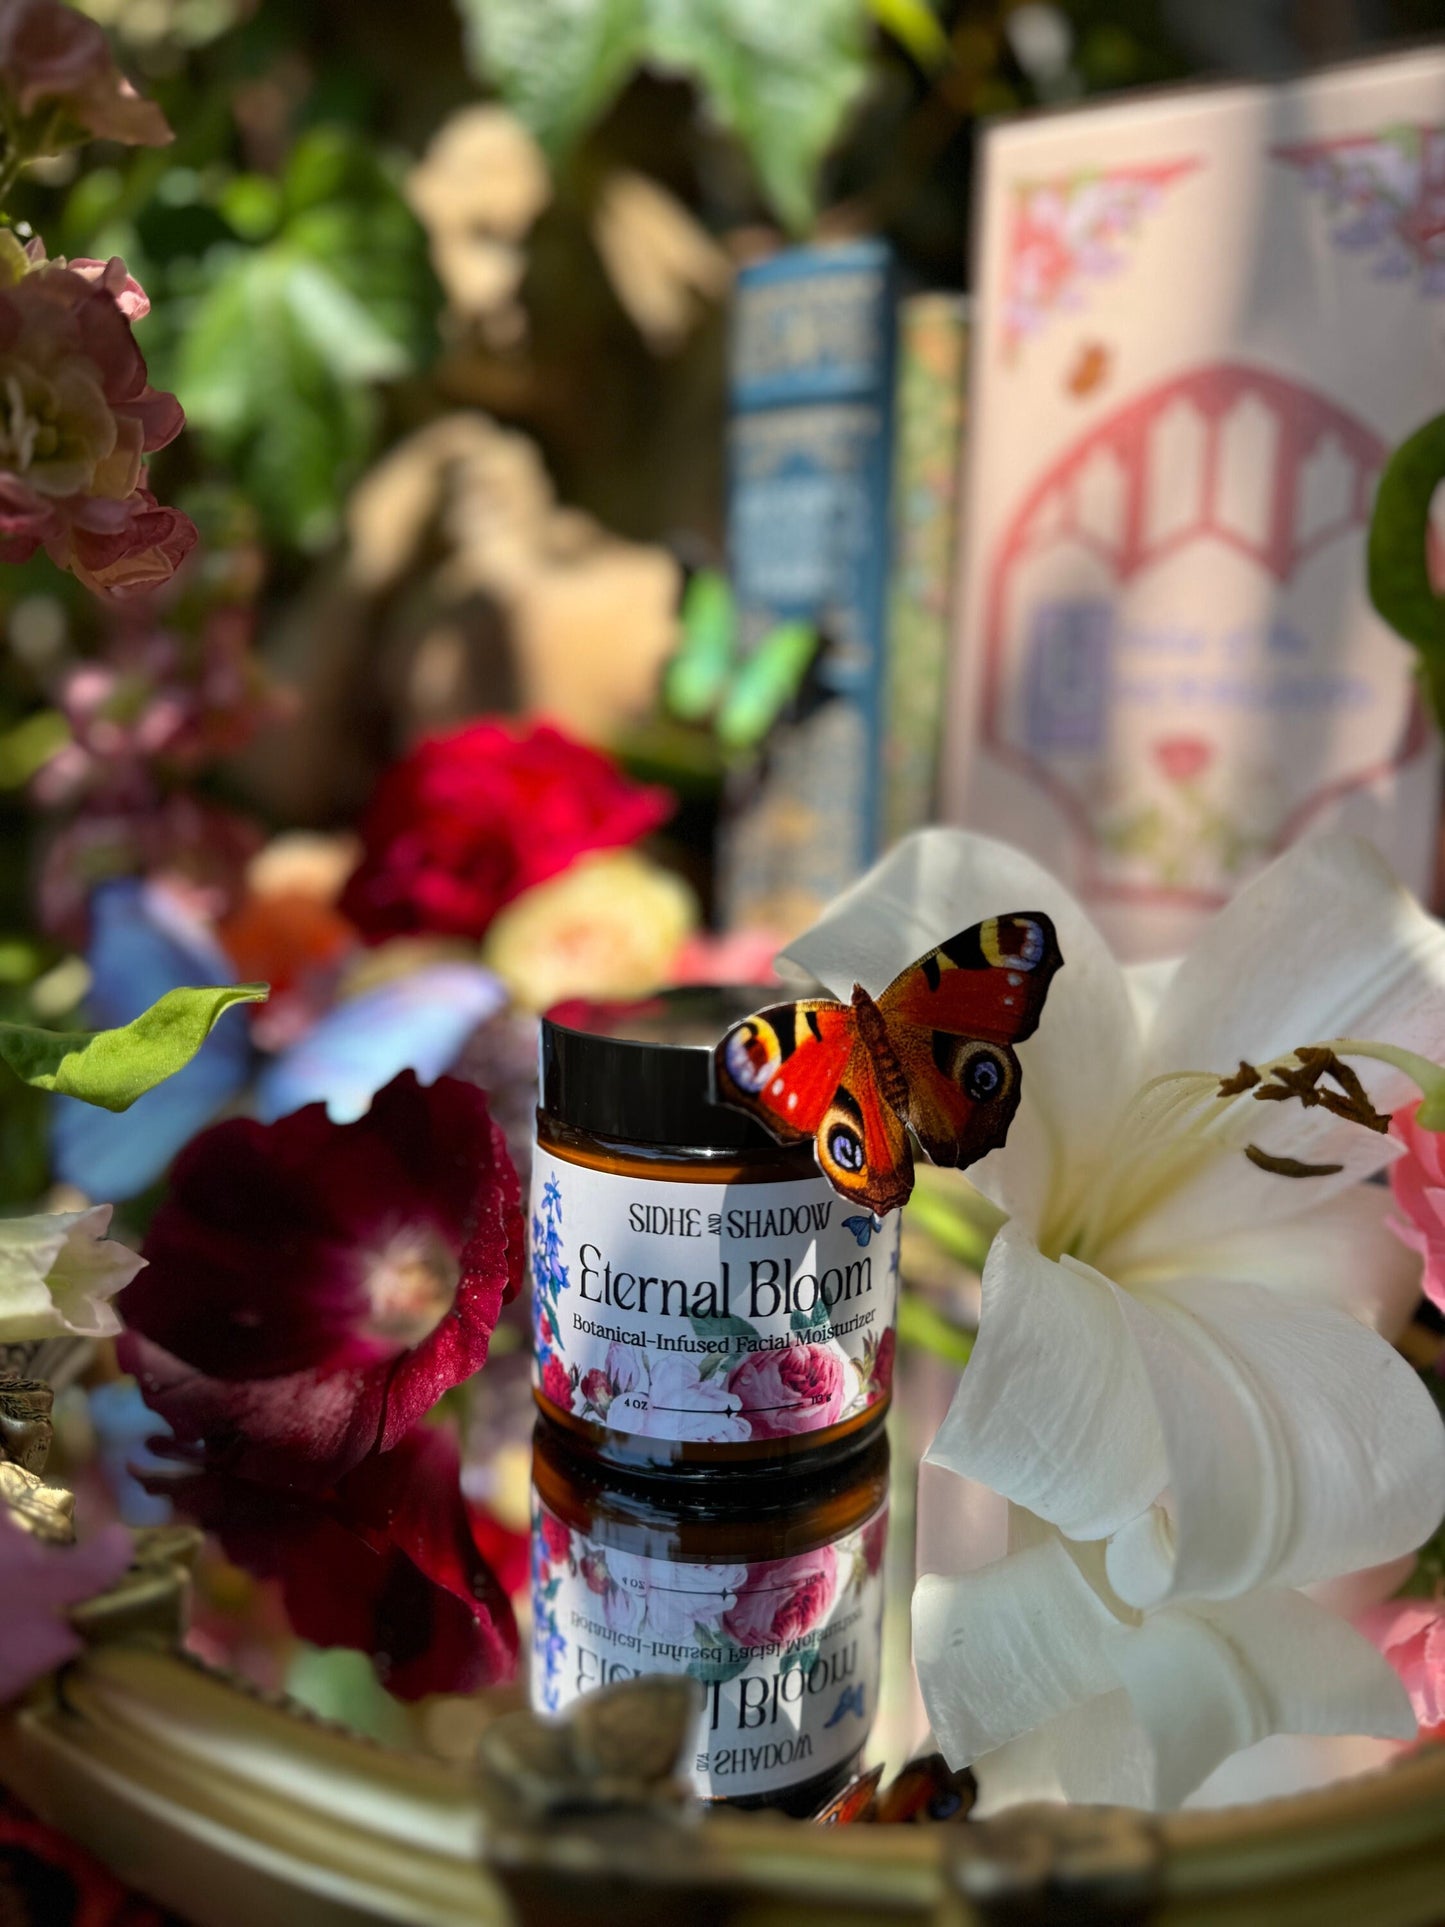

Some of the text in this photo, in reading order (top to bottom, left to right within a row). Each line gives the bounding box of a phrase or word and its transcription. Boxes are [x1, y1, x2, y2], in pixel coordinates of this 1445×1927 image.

[628, 1200, 834, 1239] SIDHE AND SHADOW
[578, 1243, 872, 1319] Eternal Bloom
[572, 1308, 876, 1354] Botanical-Infused Facial Moisturizer
[624, 1398, 631, 1408] 4
